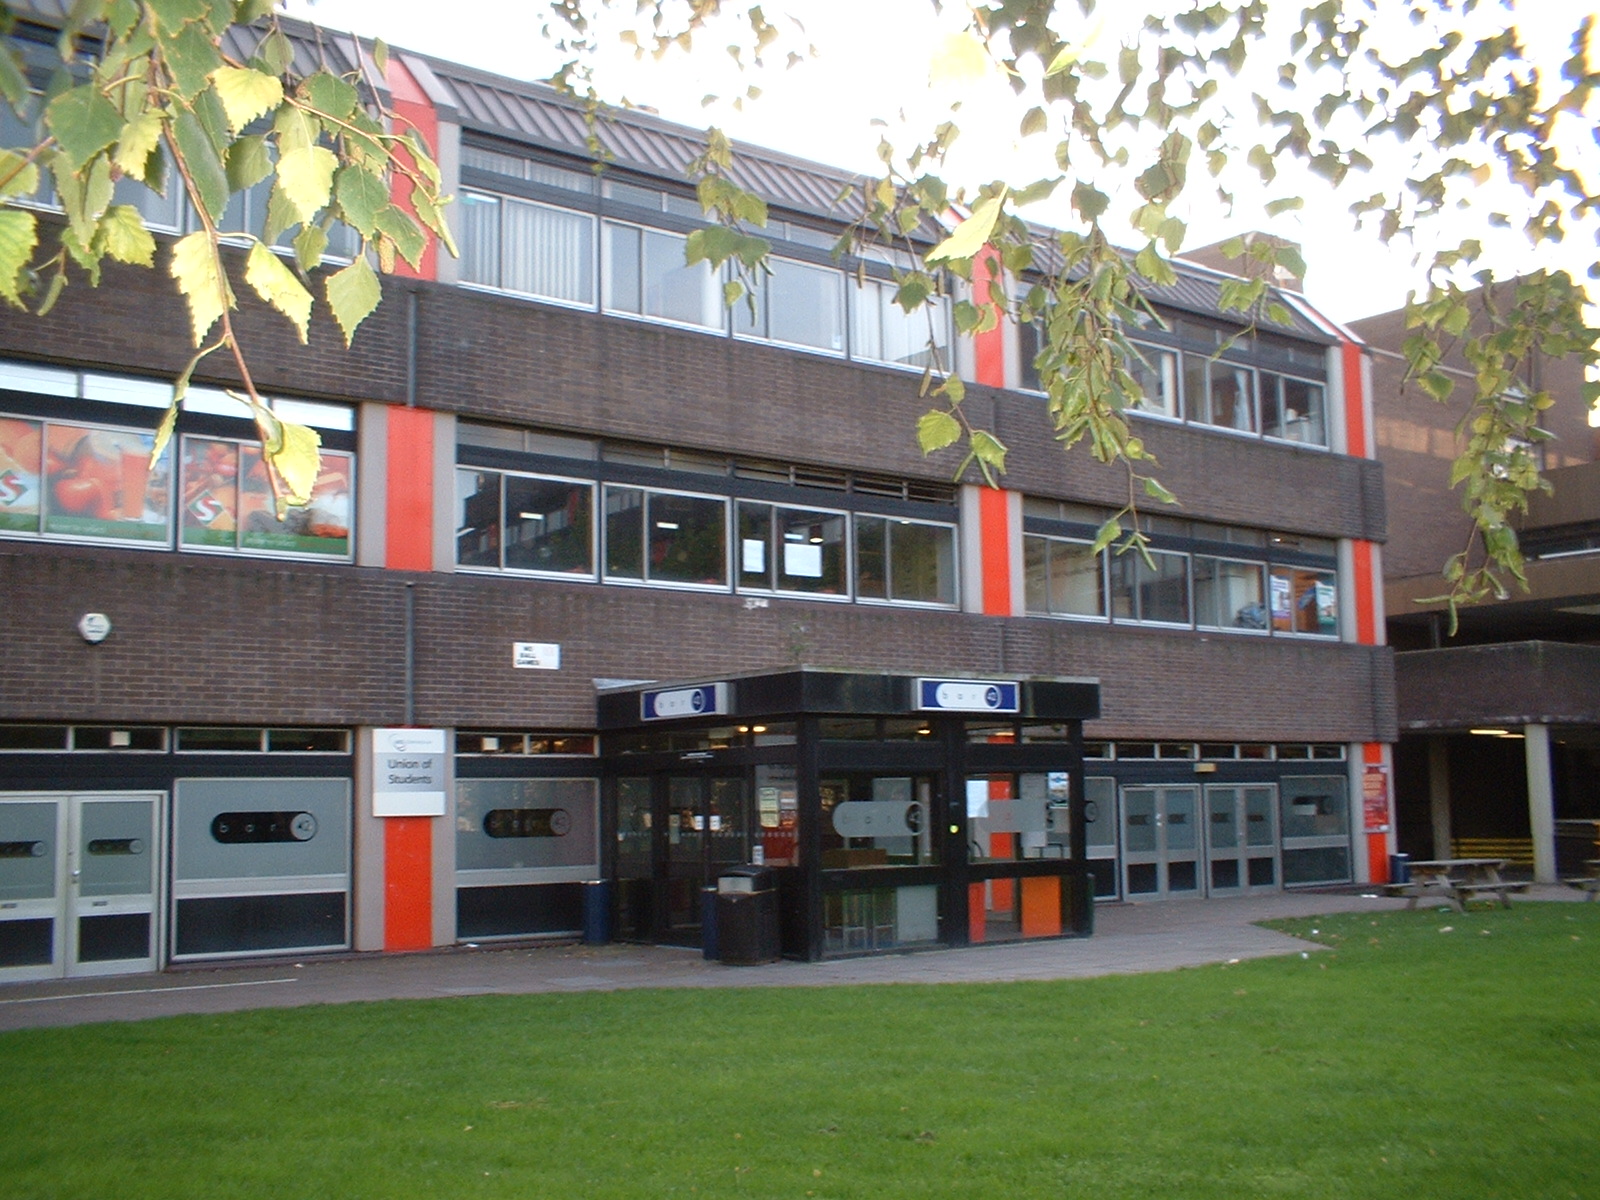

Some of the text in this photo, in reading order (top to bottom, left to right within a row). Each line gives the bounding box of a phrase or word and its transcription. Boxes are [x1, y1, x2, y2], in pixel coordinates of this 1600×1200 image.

[387, 758, 433, 769] Union of
[388, 773, 432, 785] Students
